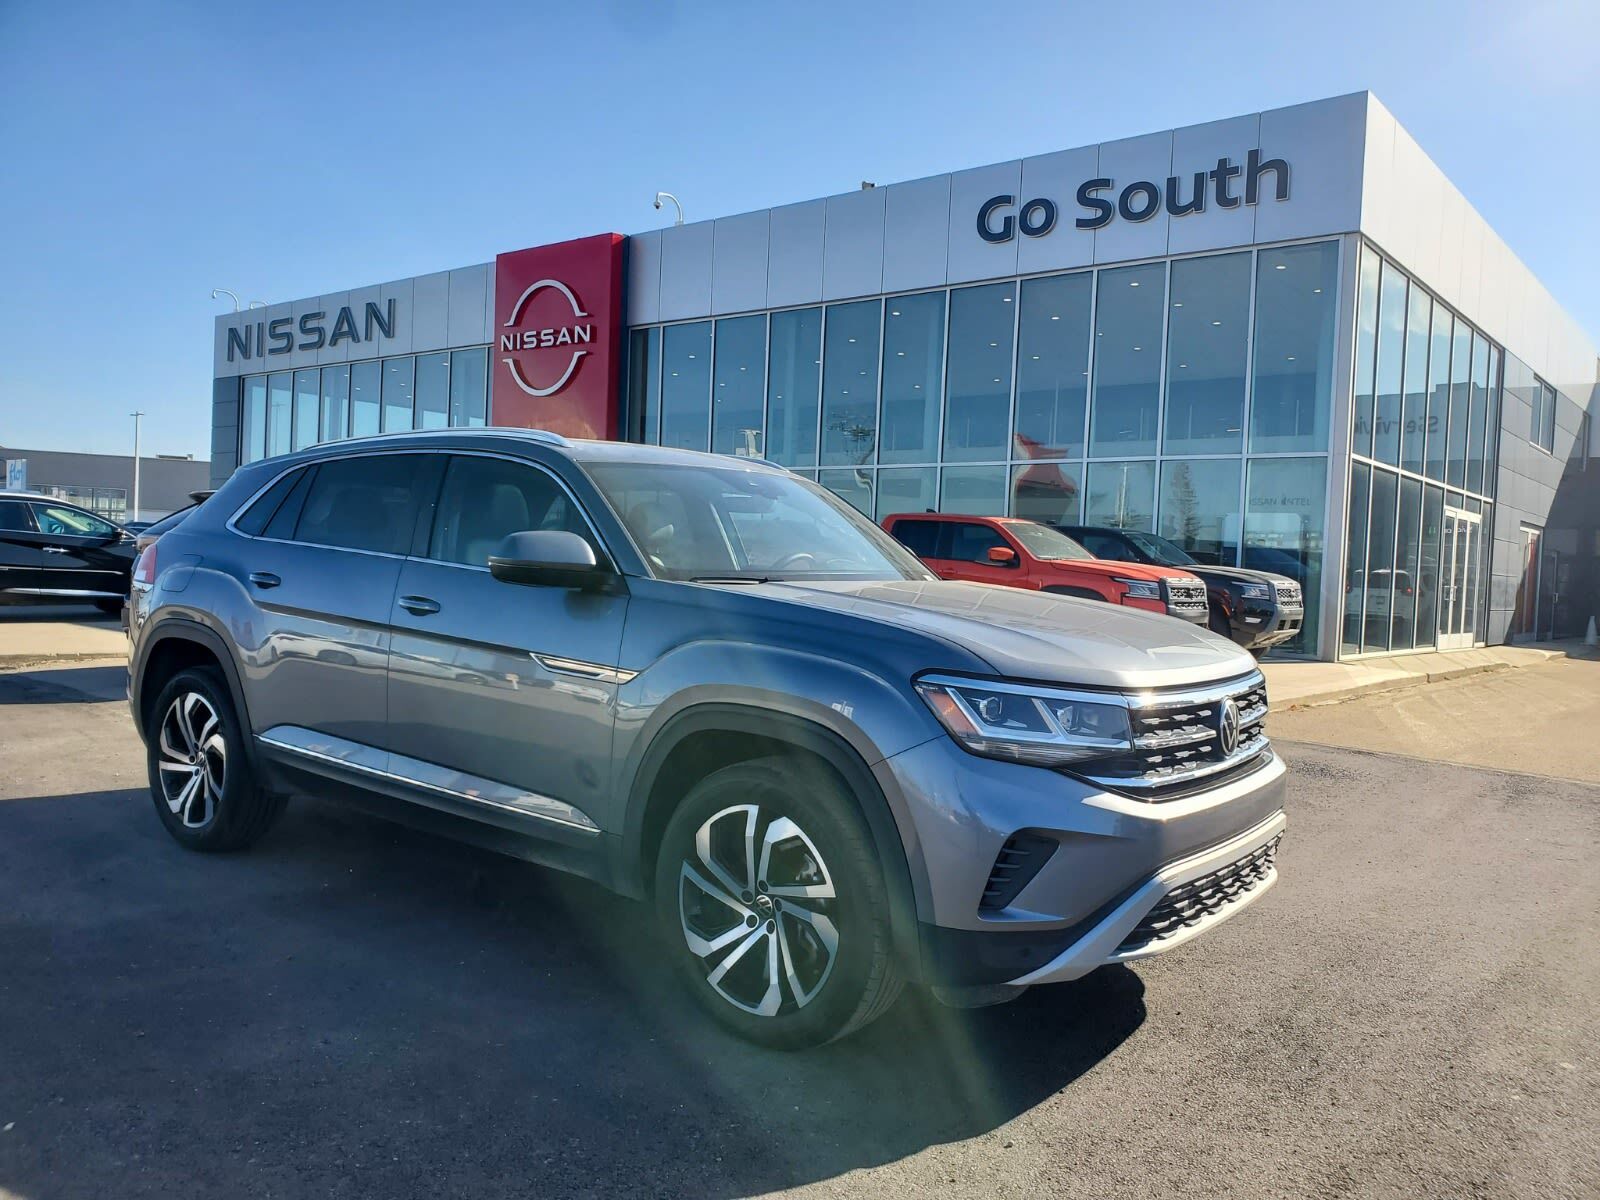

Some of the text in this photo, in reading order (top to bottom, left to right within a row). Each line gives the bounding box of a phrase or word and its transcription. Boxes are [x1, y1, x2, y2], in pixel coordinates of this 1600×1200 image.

[976, 149, 1291, 243] Go South
[227, 299, 396, 362] NISSAN
[500, 324, 590, 351] NISSAN
